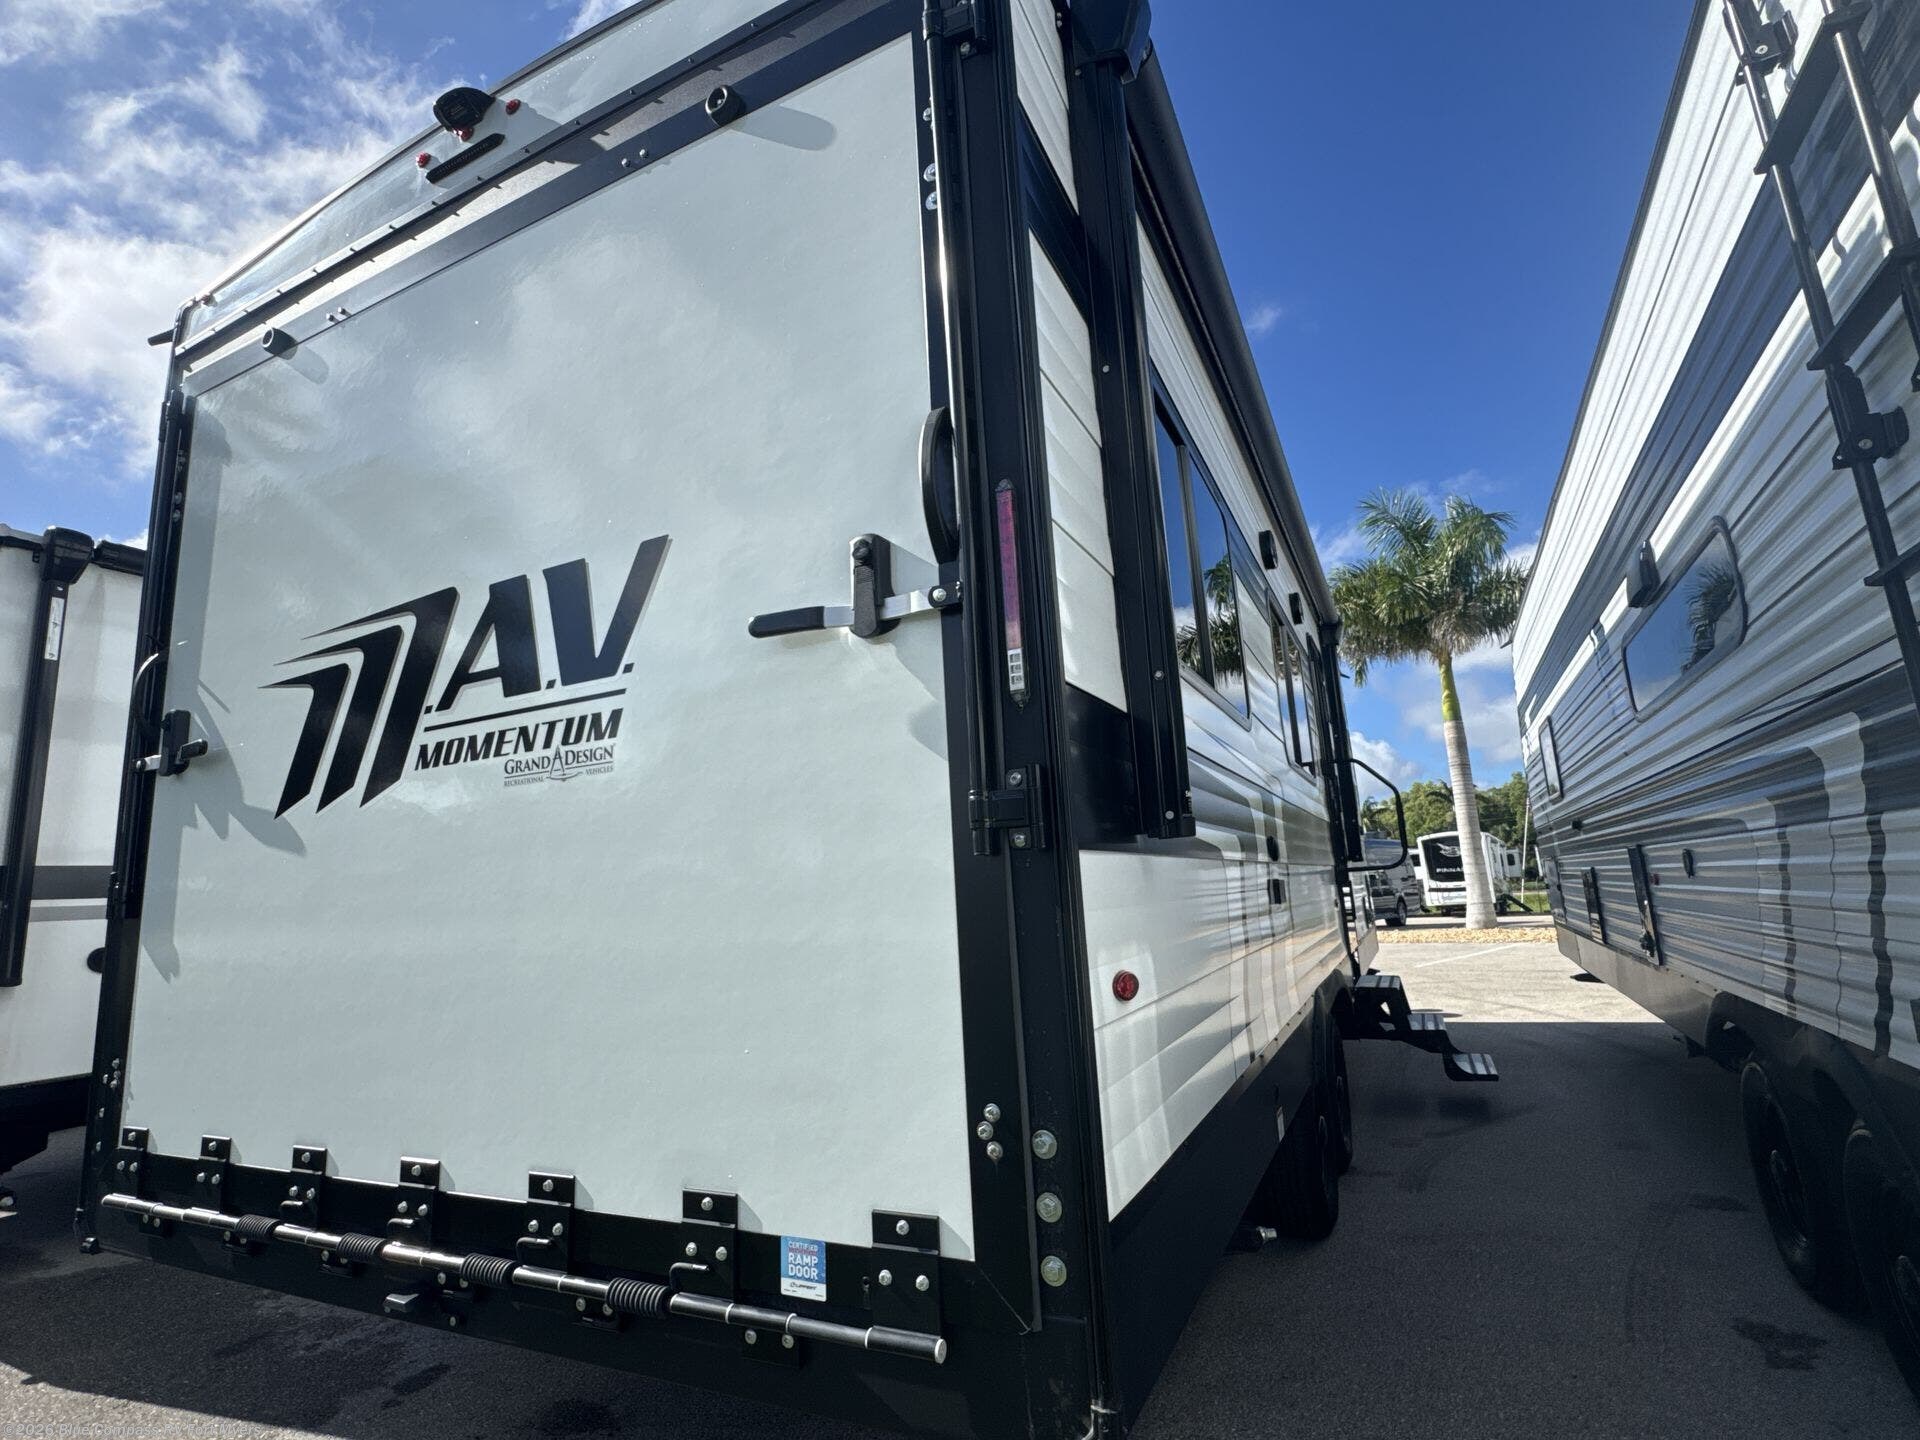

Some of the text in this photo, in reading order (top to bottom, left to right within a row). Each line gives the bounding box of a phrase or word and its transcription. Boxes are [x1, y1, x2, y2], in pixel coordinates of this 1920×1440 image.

[414, 707, 624, 771] MOMENTUM
[504, 745, 614, 775] GRAND DESIGN
[788, 1241, 818, 1251] CERTIFIED
[788, 1253, 818, 1267] RAMP
[788, 1264, 818, 1280] DOOR
